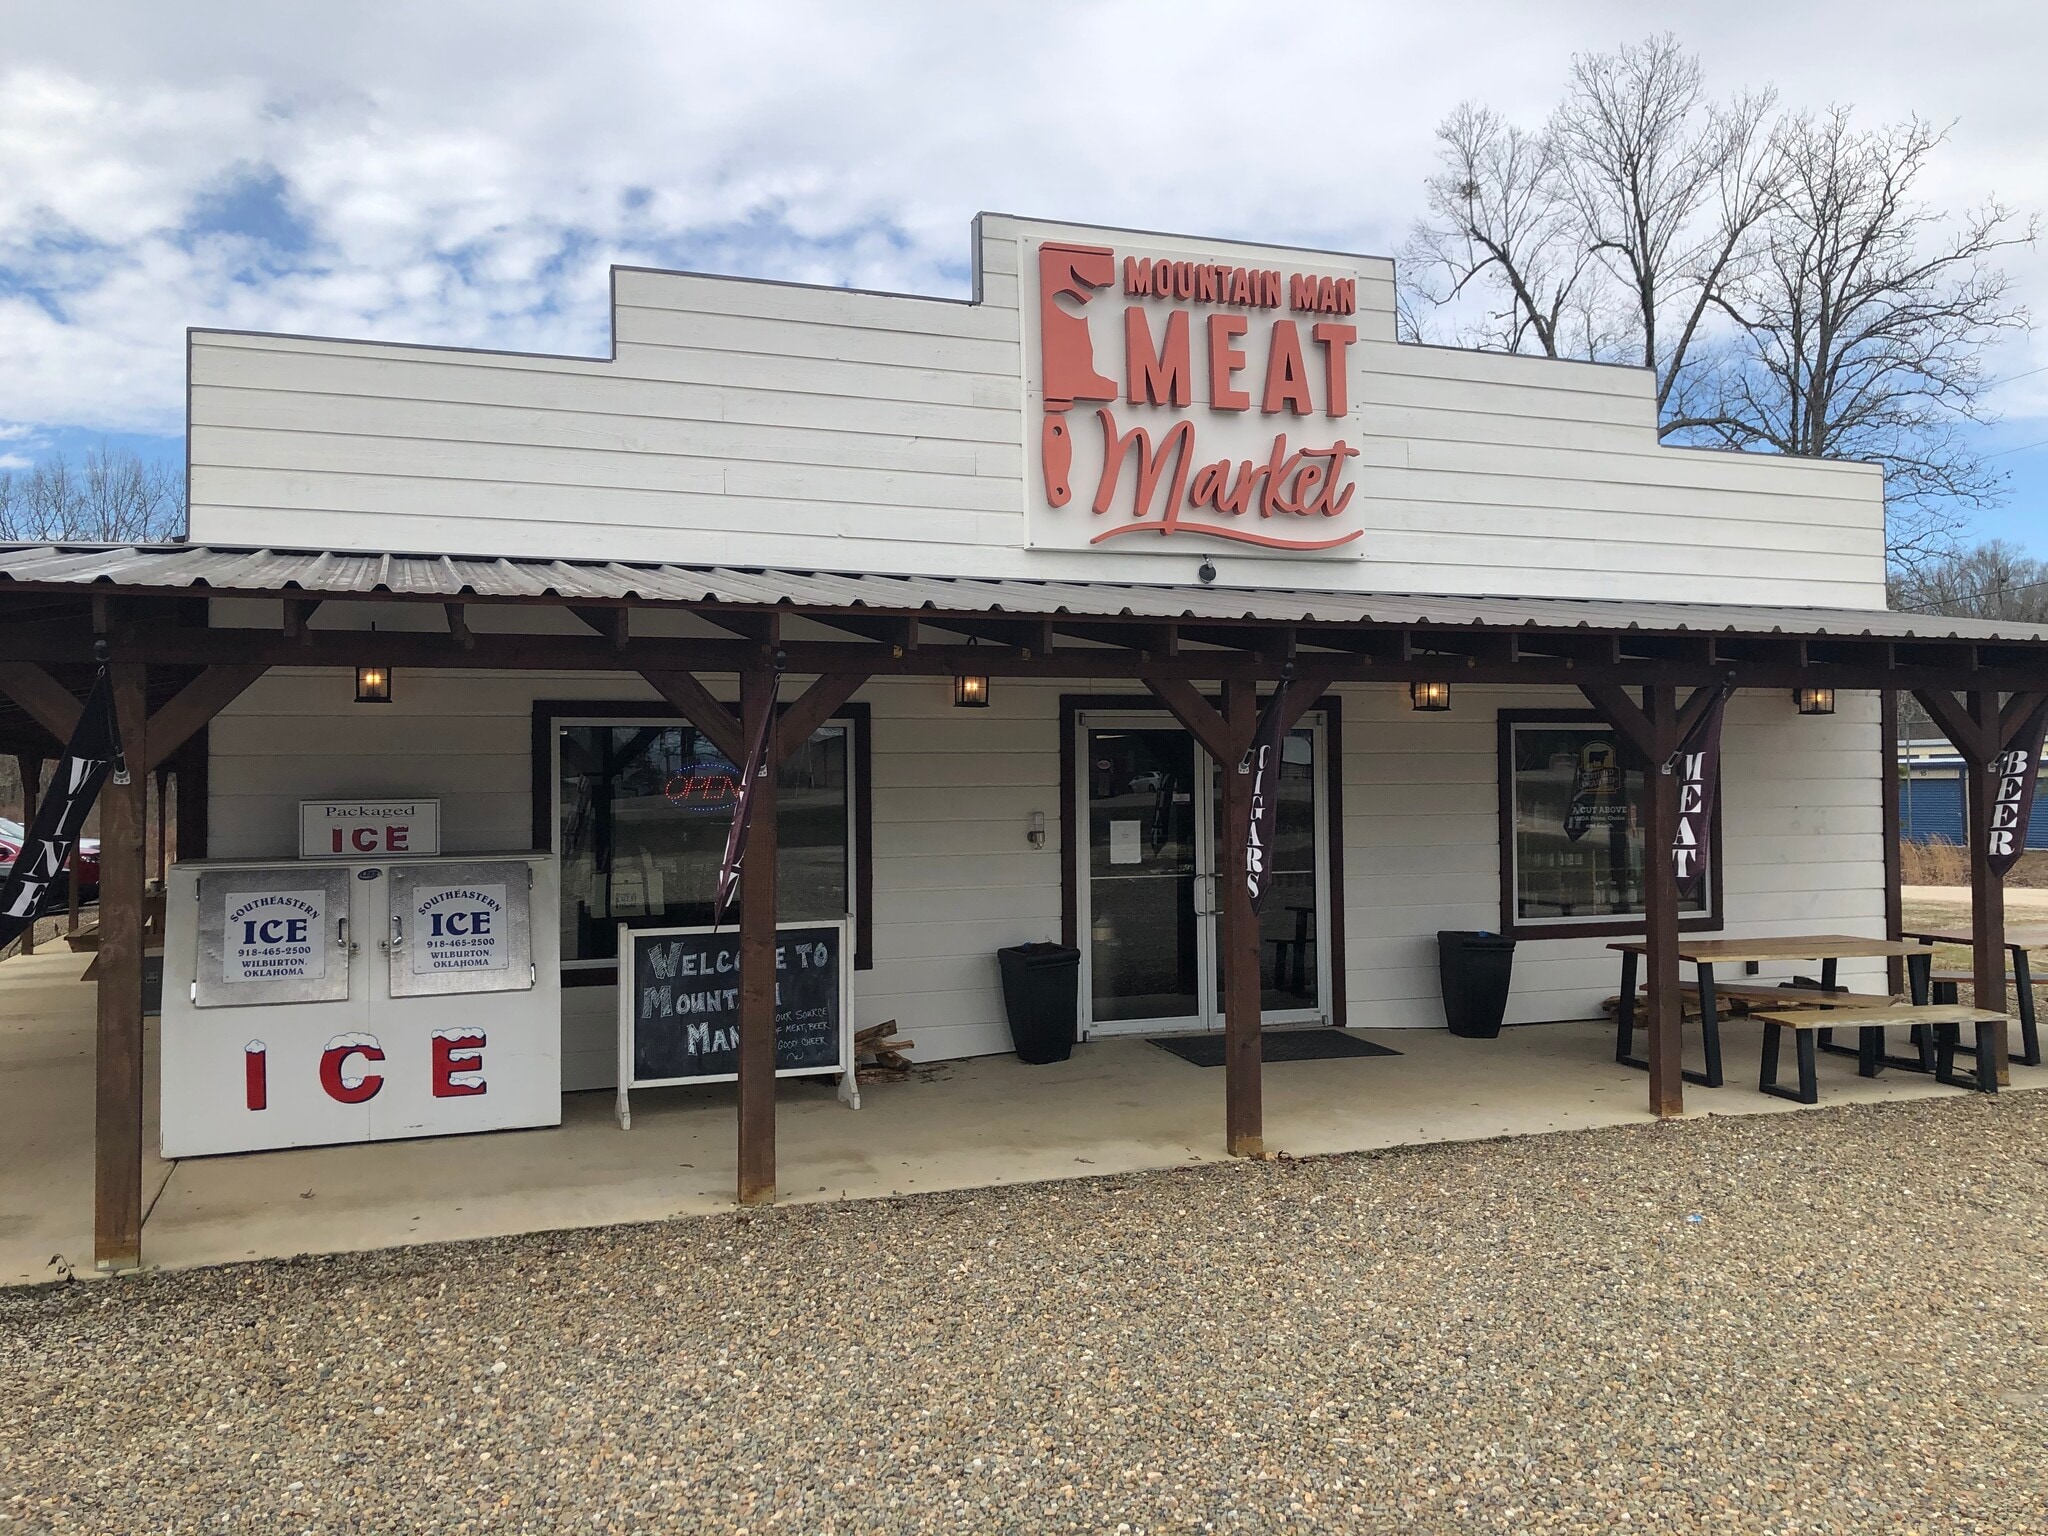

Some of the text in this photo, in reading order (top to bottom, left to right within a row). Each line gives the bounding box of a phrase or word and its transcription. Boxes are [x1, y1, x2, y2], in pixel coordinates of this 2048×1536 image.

[1123, 256, 1356, 316] MOUNTAIN MAN
[1125, 306, 1357, 418] MEAT
[1091, 407, 1361, 536] Market
[664, 775, 743, 800] OPEN
[325, 806, 416, 818] Packaged
[1579, 806, 1597, 814] CUT
[1598, 806, 1628, 814] ABOVE
[1672, 752, 1707, 878] MEAT
[1988, 750, 2028, 856] BEER
[1246, 744, 1271, 898] CIGARS
[2, 756, 107, 918] WINE
[331, 824, 410, 853] ICE
[230, 896, 320, 923] SOUTHEASTERN
[417, 889, 502, 916] SOUTHEASTERN
[243, 918, 308, 945] ICE
[431, 911, 491, 937] ICE
[238, 946, 311, 957] 918-465-2500
[427, 937, 495, 948] 918-465-2500
[244, 968, 304, 978] OKLAHOMA
[433, 958, 489, 968] OKLAHOMA
[648, 941, 828, 979] WELCE TO
[642, 982, 782, 1018] MOUNT
[776, 1007, 828, 1022] OUR SOURCE
[809, 1021, 831, 1031] BEER
[777, 1036, 828, 1050] GOOD CHEER
[244, 1027, 487, 1111] ICE
